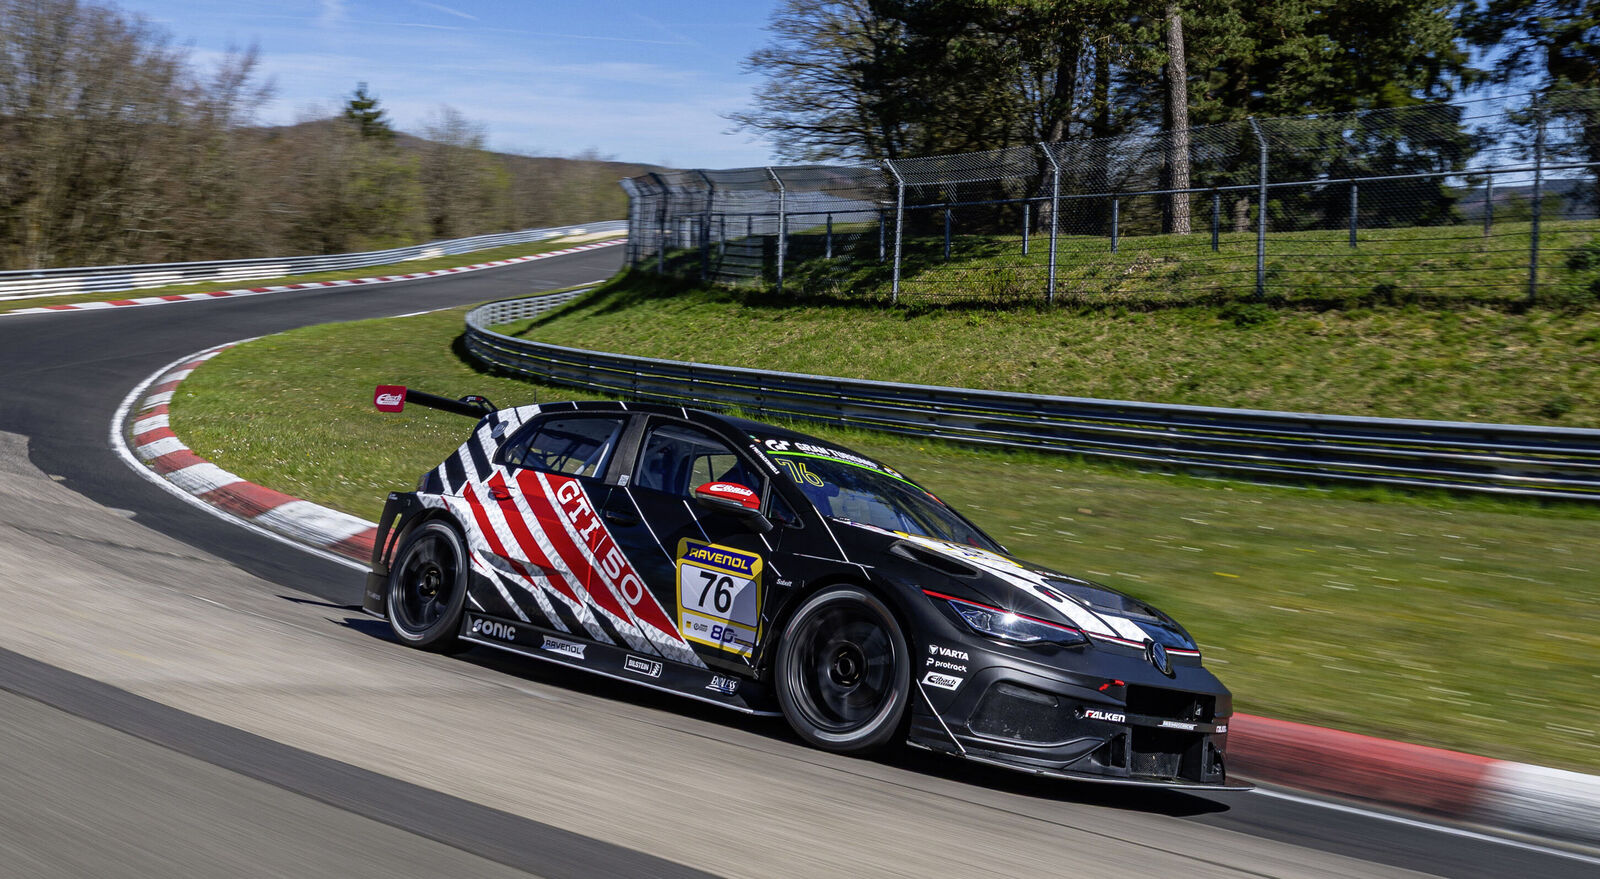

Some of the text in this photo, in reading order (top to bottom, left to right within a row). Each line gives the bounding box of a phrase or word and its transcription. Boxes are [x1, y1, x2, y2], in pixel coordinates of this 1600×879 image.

[794, 442, 833, 457] GRAN
[774, 458, 824, 488] 76
[556, 480, 643, 606] GTI 50
[688, 547, 749, 570] RAVENOL
[698, 570, 734, 614] 76
[472, 618, 516, 641] SONIC
[545, 639, 582, 655] RAVENOL
[939, 647, 969, 661] VARTA
[628, 659, 650, 671] BILSTEIN
[935, 660, 967, 673] protrack
[1085, 709, 1126, 723] FALKEN
